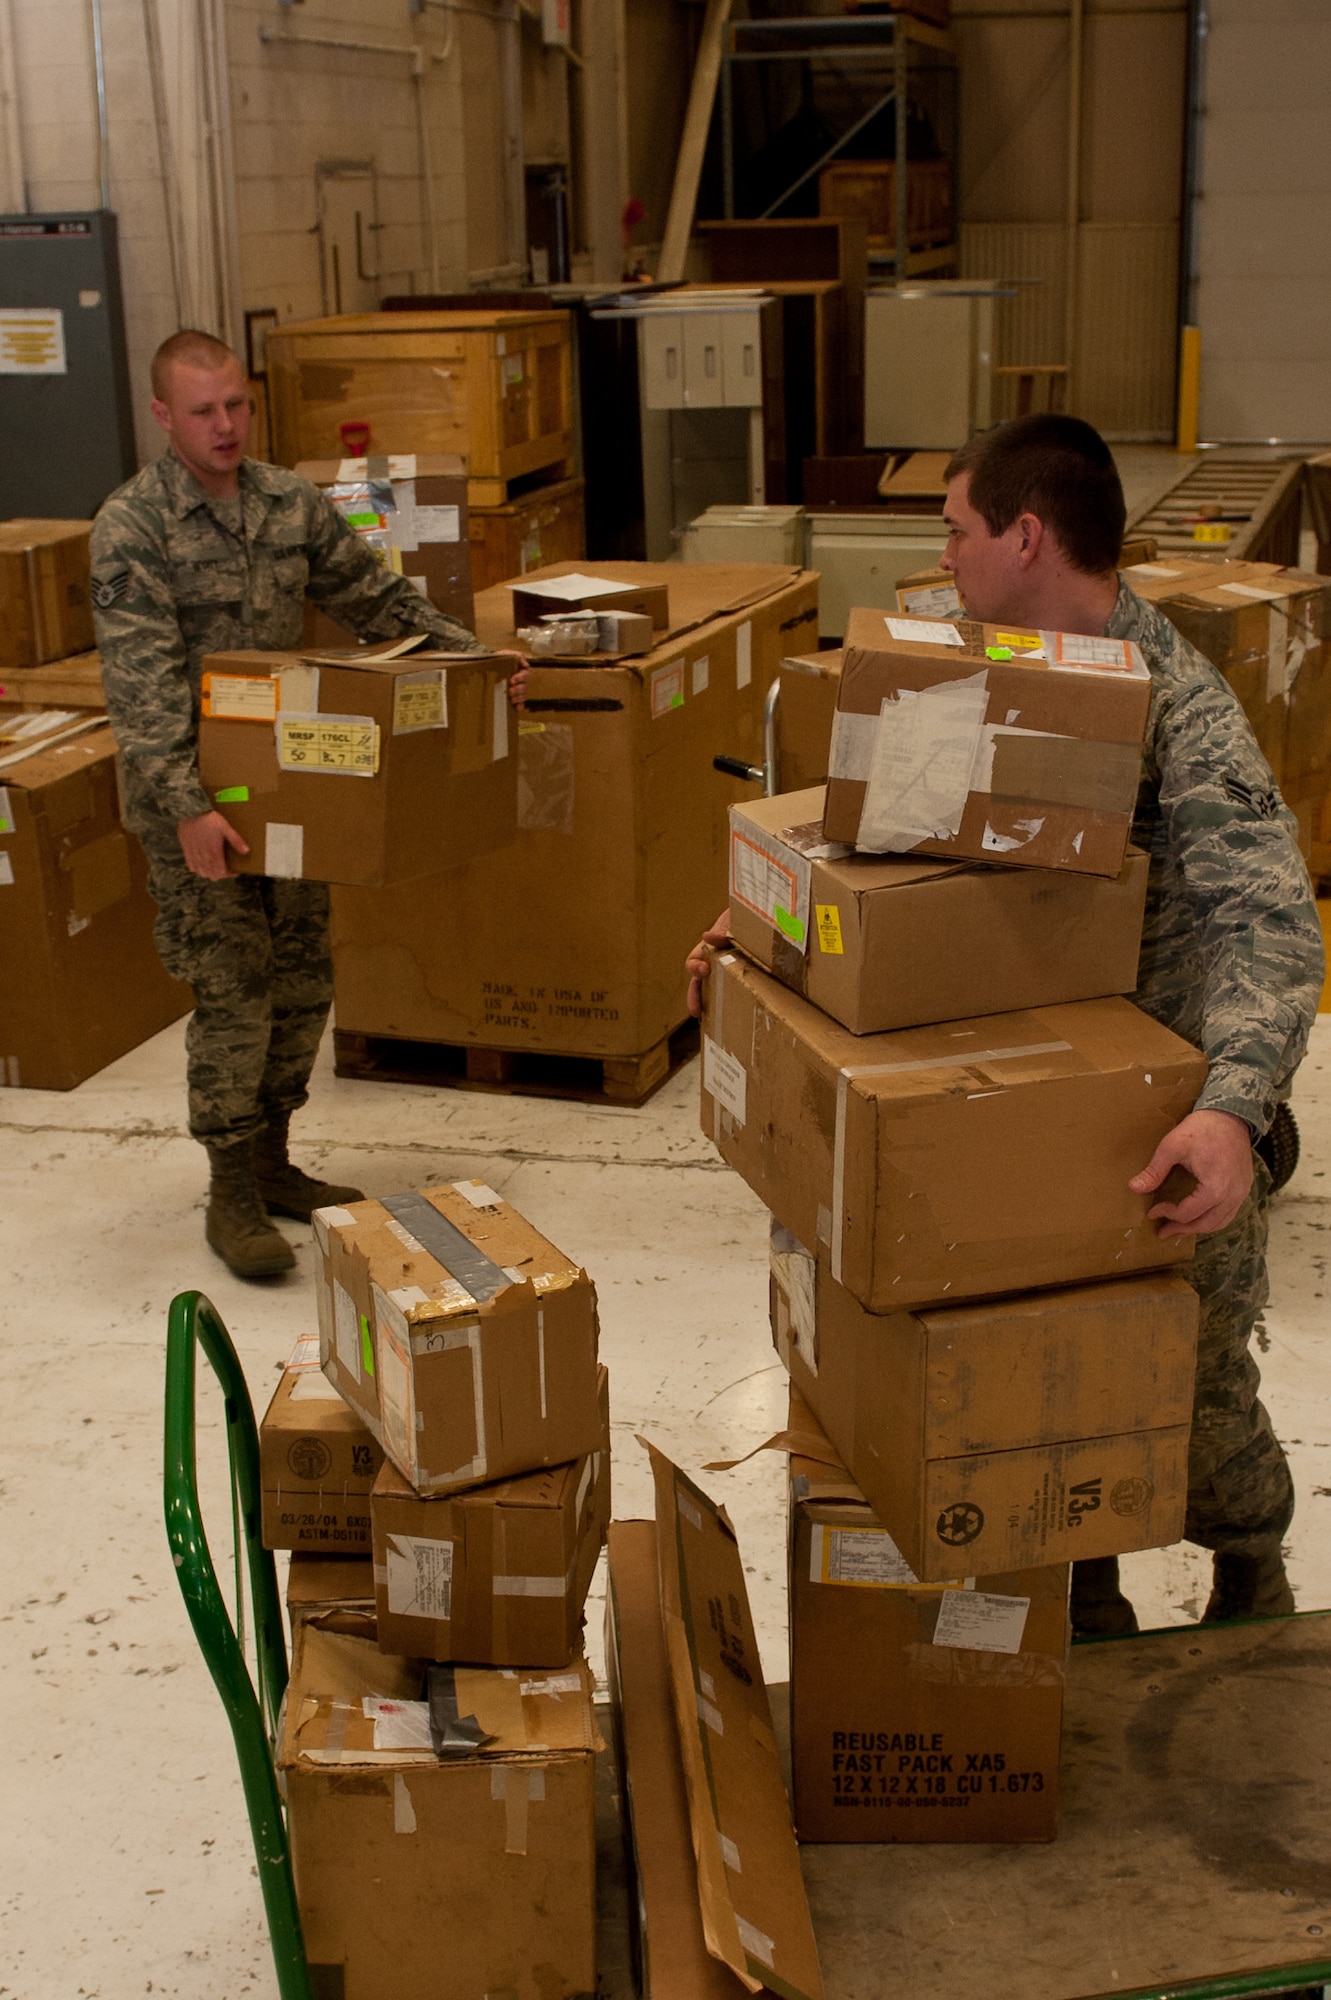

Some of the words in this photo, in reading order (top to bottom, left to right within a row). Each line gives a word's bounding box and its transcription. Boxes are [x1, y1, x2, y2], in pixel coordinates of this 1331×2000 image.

[288, 732, 315, 740] MRSP
[554, 989, 581, 1001] USA
[591, 991, 609, 1002] OF
[512, 1000, 537, 1013] AND
[548, 1004, 619, 1020] IMPORTED
[485, 1014, 536, 1029] PARTS.
[1068, 1477, 1102, 1528] V3c
[832, 1732, 944, 1751] REUSABLE
[832, 1753, 886, 1772] FAST
[898, 1754, 954, 1772] PACK
[966, 1753, 1006, 1772] XA5
[832, 1776, 854, 1793] 12
[861, 1776, 872, 1793] X
[879, 1777, 900, 1793] 12
[906, 1776, 918, 1793] X
[924, 1777, 946, 1794] 18
[957, 1776, 982, 1793] CU
[989, 1772, 1044, 1792] 1.673
